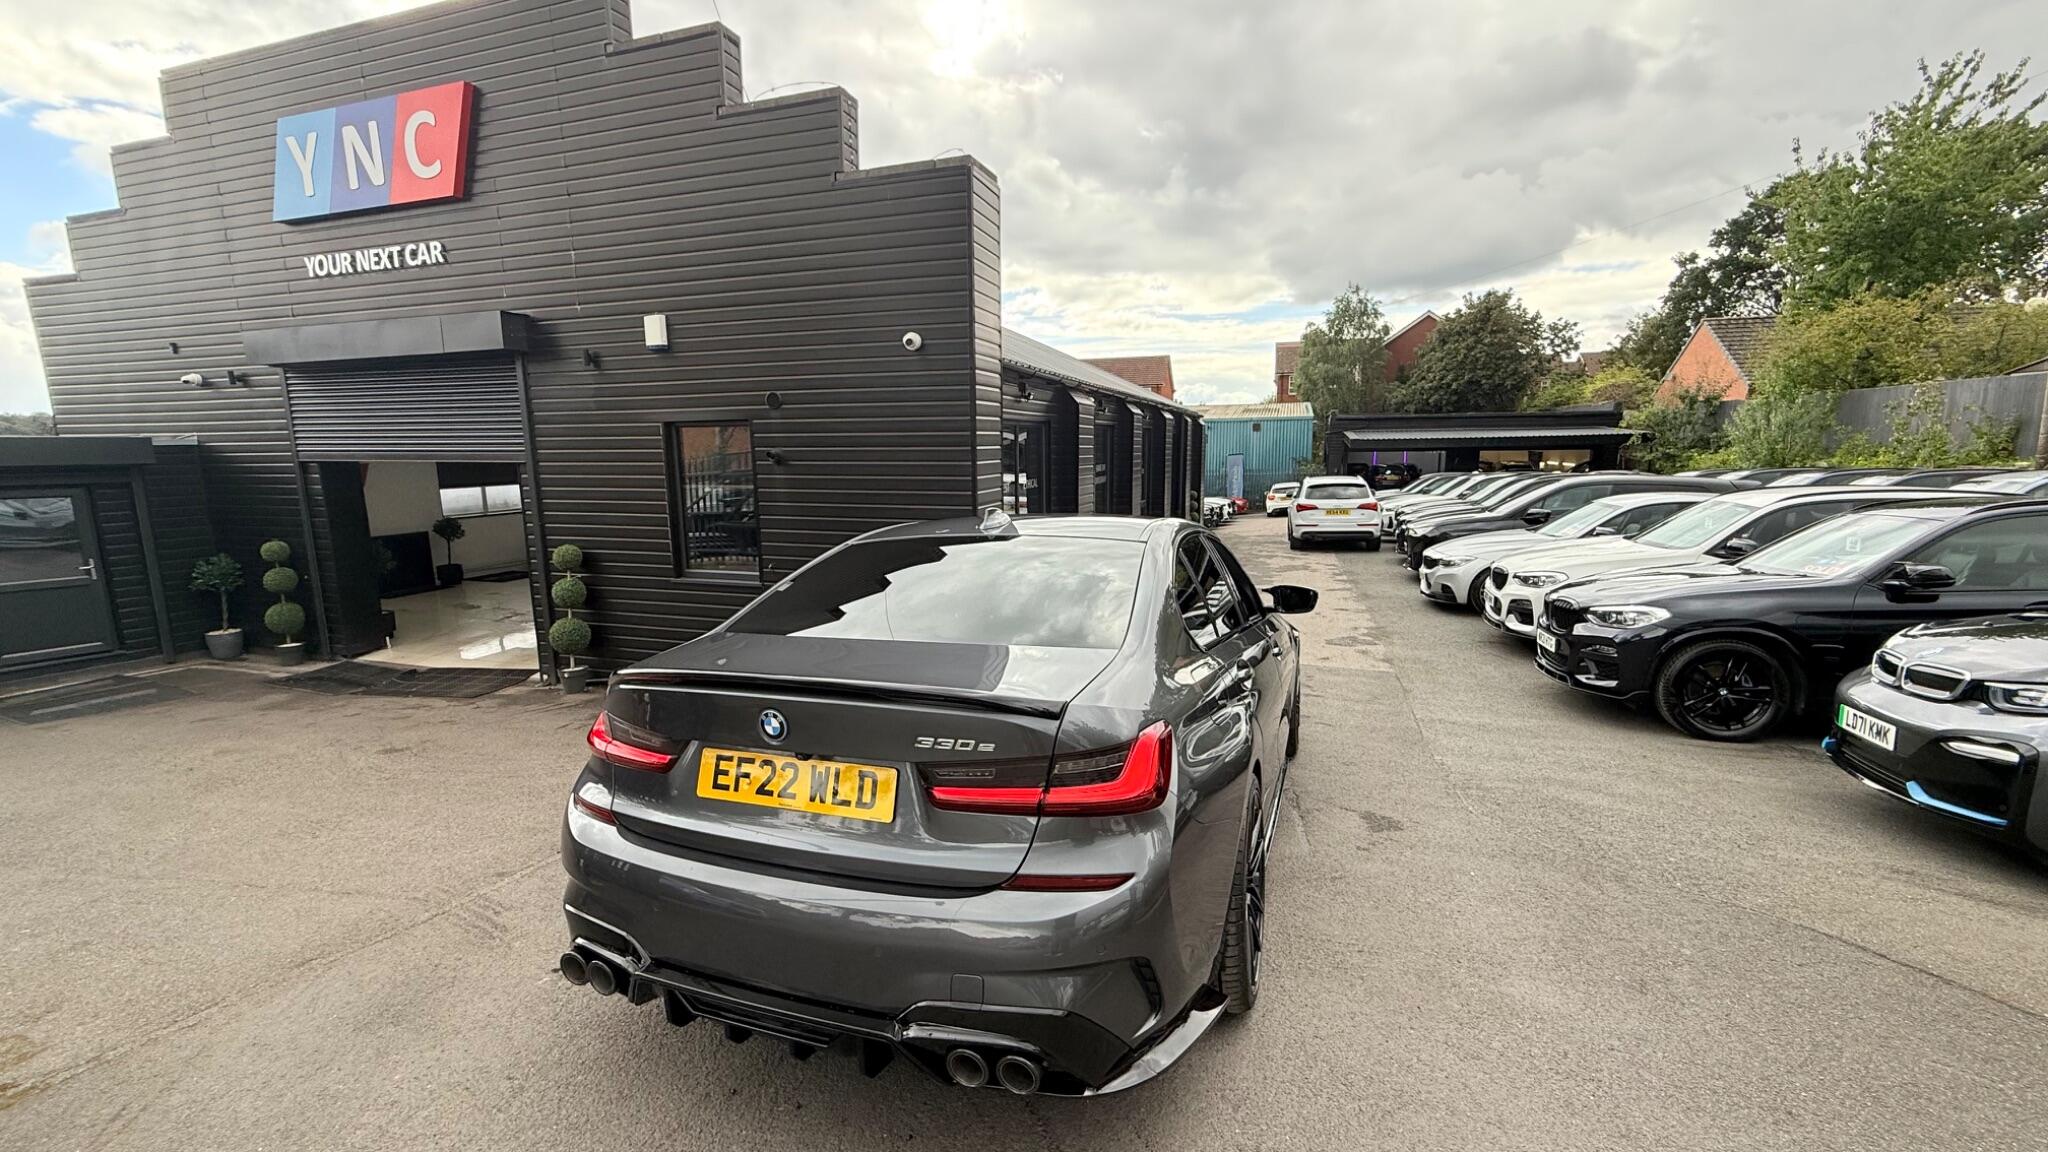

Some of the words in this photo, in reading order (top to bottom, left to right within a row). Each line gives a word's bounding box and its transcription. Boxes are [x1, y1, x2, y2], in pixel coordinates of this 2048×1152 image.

[284, 110, 442, 197] YNC
[303, 252, 354, 278] YOUR
[355, 246, 402, 272] NEXT
[405, 240, 444, 267] CAR
[914, 736, 996, 752] 330e
[1846, 710, 1867, 734] LD71
[1868, 720, 1890, 745] KMK
[711, 754, 800, 801] EF22
[809, 764, 878, 810] WLD
